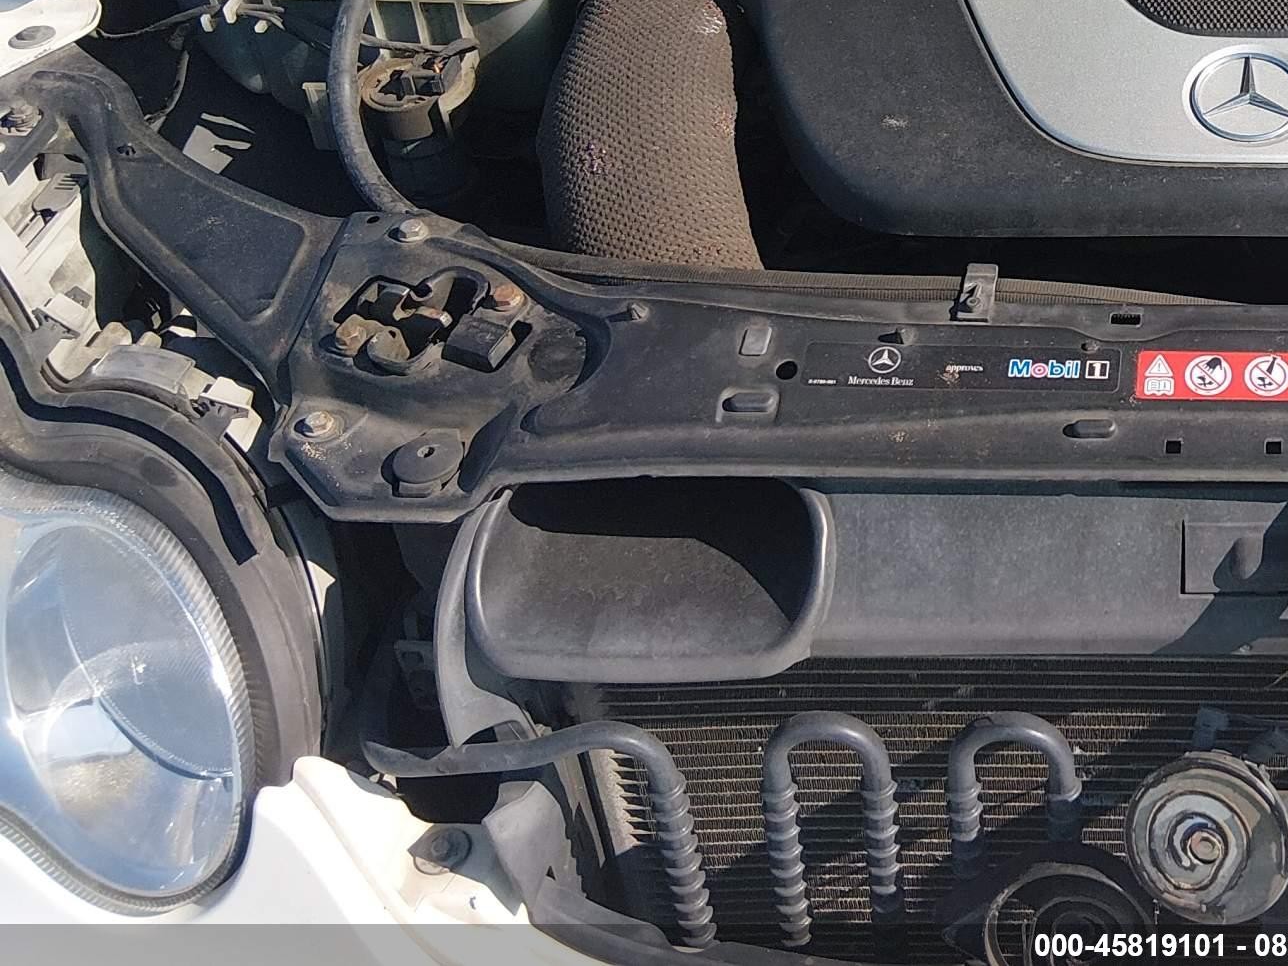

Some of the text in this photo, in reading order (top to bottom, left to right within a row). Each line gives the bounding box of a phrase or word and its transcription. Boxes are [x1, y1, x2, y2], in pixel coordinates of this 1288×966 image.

[945, 364, 983, 372] approves
[1008, 359, 1081, 378] Mobil
[848, 375, 890, 386] Mercedes
[891, 376, 914, 386] Benz
